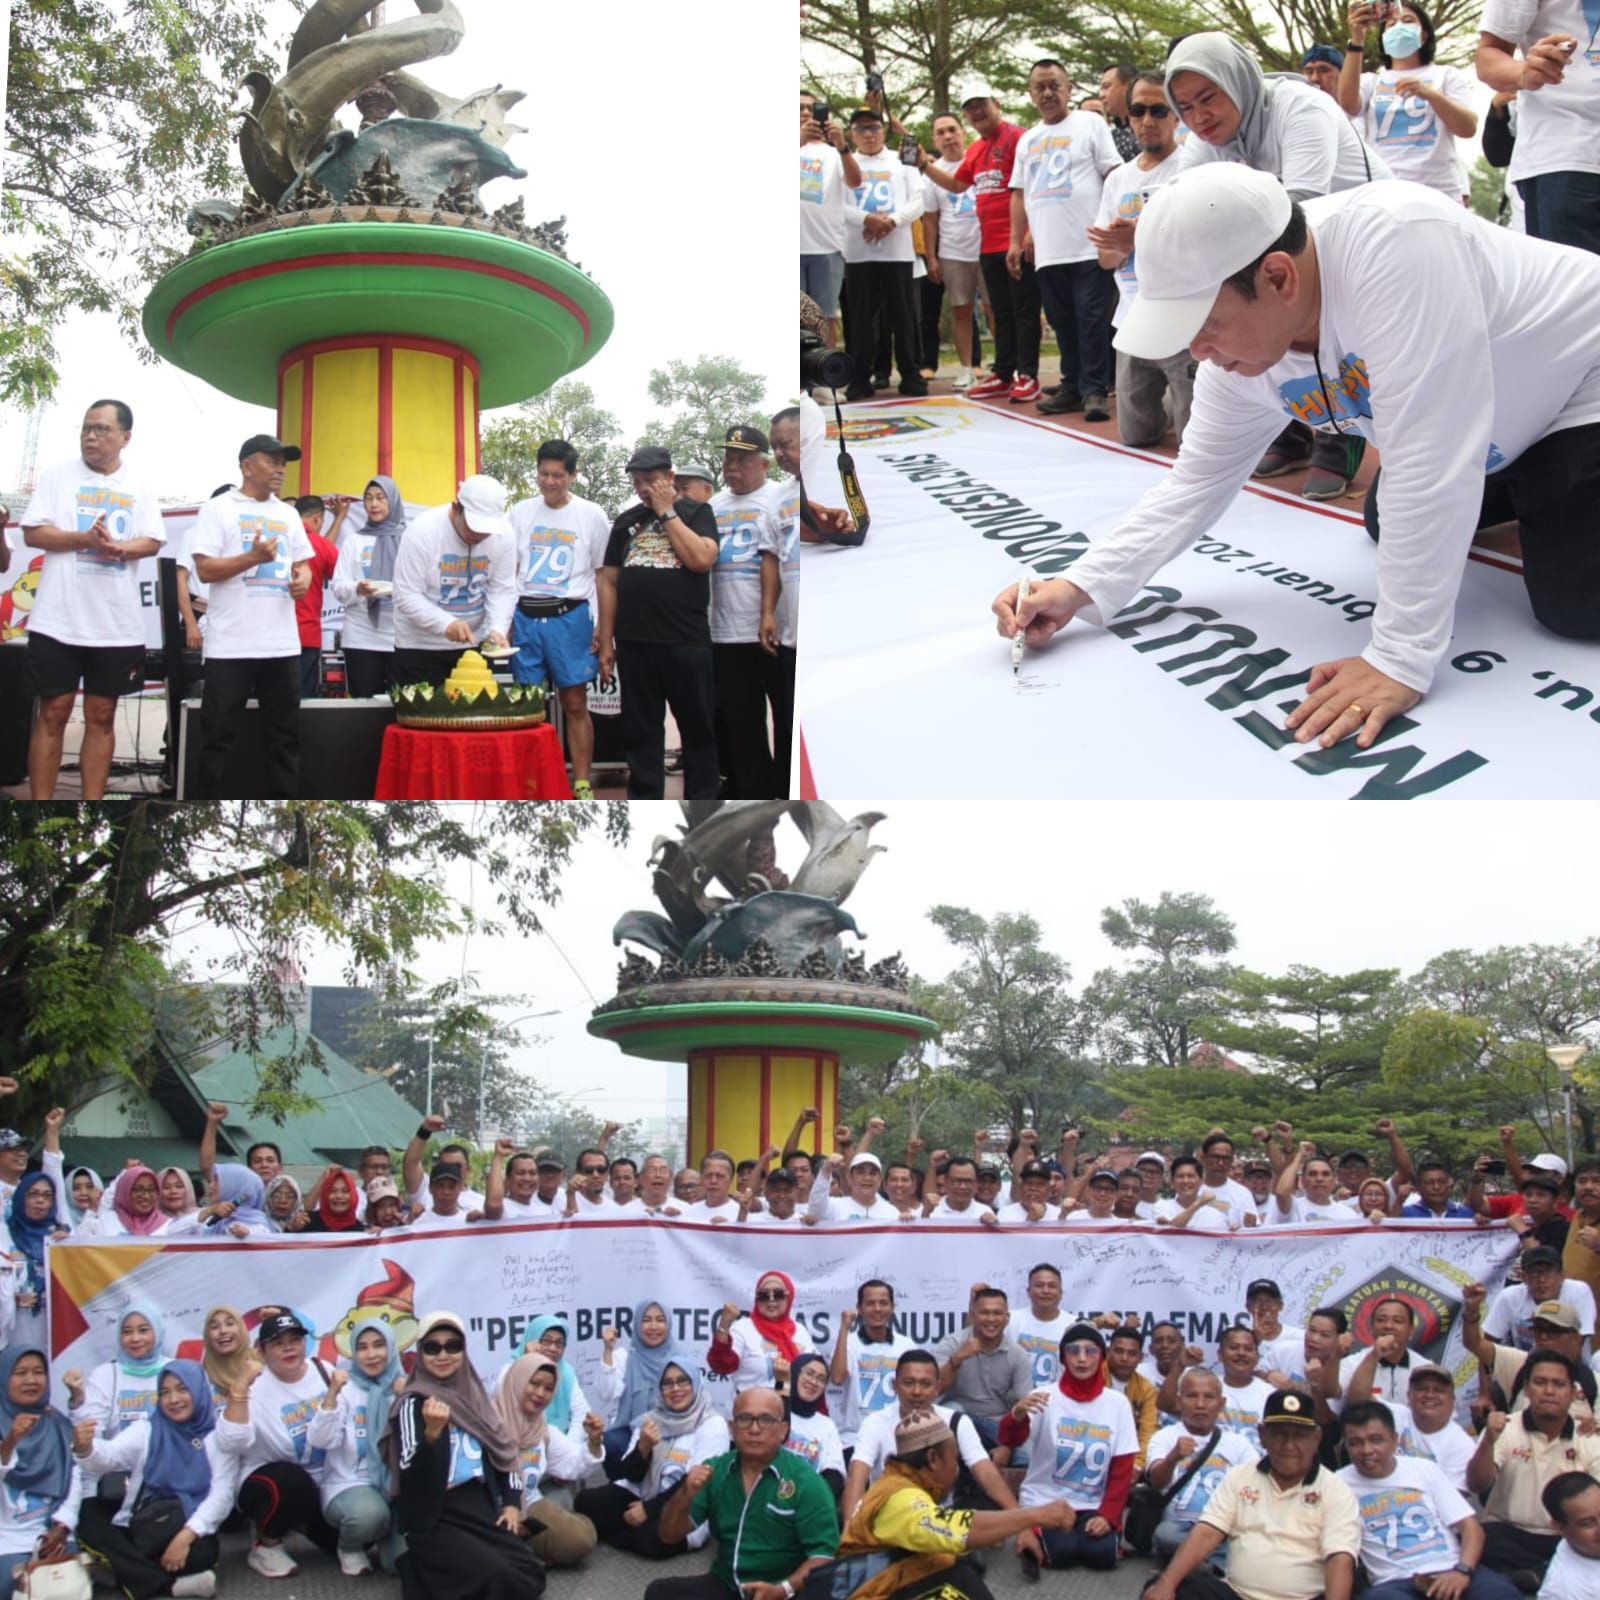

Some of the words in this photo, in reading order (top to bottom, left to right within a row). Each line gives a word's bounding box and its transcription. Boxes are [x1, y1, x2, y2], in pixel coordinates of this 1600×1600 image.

[1375, 95, 1435, 138] 79
[1028, 149, 1072, 196] 79
[856, 181, 894, 212] 79
[717, 522, 761, 562] 79
[923, 477, 1091, 581] NDONESIA
[524, 545, 576, 584] 79
[1236, 561, 1376, 623] bruari
[1451, 650, 1508, 674] 9
[1054, 1438, 1112, 1486] 79
[1364, 1504, 1438, 1548] 79
